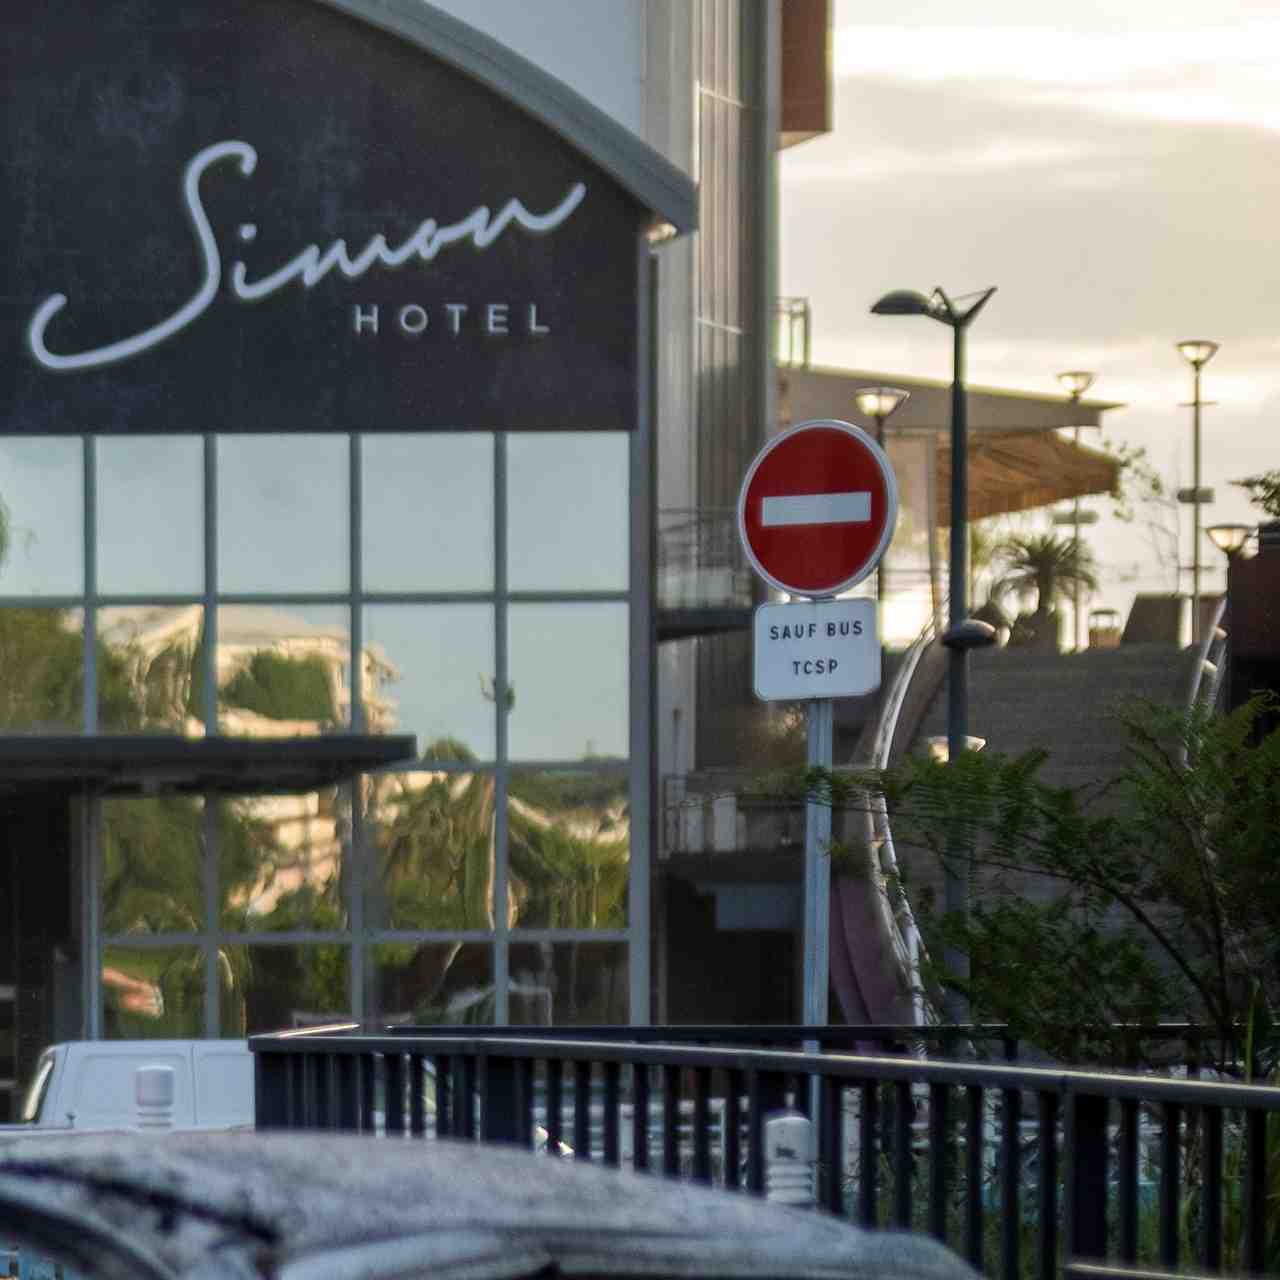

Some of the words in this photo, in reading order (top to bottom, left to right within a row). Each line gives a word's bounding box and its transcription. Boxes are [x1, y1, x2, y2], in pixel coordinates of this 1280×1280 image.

[30, 140, 586, 370] Simon
[355, 303, 550, 335] HOTEL
[770, 623, 817, 641] SAUF
[826, 620, 864, 637] BUS
[792, 659, 840, 676] TCSP
